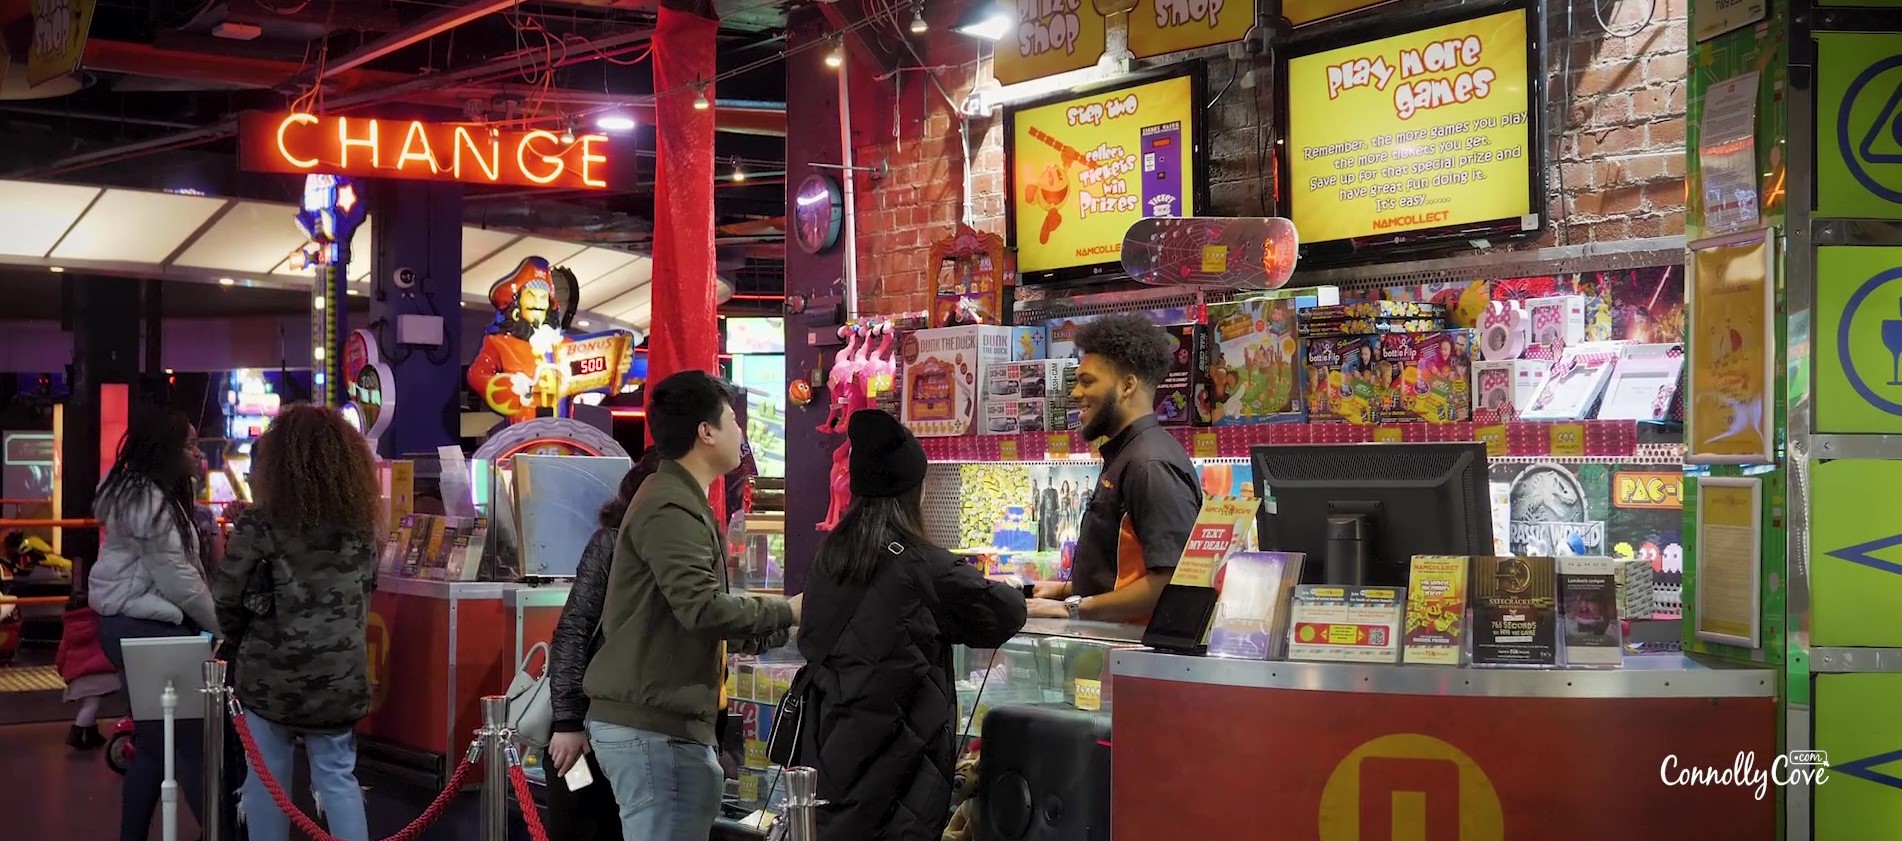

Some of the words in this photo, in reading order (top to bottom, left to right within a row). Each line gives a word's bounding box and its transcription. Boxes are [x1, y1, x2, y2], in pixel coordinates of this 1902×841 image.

[1394, 67, 1496, 120] games
[1371, 134, 1392, 148] the
[1397, 129, 1427, 144] more
[1431, 121, 1469, 139] games
[1472, 116, 1497, 132] you
[1501, 110, 1528, 128] play
[276, 112, 609, 188] CHANGE
[1334, 156, 1355, 170] the
[1358, 150, 1388, 166] more
[1392, 144, 1435, 160] tickets
[1439, 139, 1462, 154] you
[1309, 174, 1337, 192] Save
[1340, 172, 1355, 187] up
[1358, 167, 1378, 182] for
[1381, 163, 1409, 178] that
[1412, 154, 1456, 173] special
[1459, 150, 1492, 168] prize
[1496, 145, 1522, 160] and
[1339, 185, 1367, 201] have
[1370, 180, 1403, 198] great
[1406, 176, 1428, 191] fun
[1432, 169, 1469, 187] doing
[1376, 197, 1396, 213] It's
[1373, 210, 1450, 230] NAMCOLLECT
[566, 337, 612, 356] BONUS
[920, 337, 941, 353] DUNK
[941, 336, 955, 351] THE
[955, 334, 976, 350] DUCK
[983, 334, 1008, 347] DUNK
[983, 346, 993, 354] THE
[580, 357, 604, 374] 500
[1201, 528, 1226, 539] TEXT
[1187, 540, 1202, 550] MY
[1202, 540, 1229, 551] DEAL!
[1503, 621, 1537, 630] SECONDS
